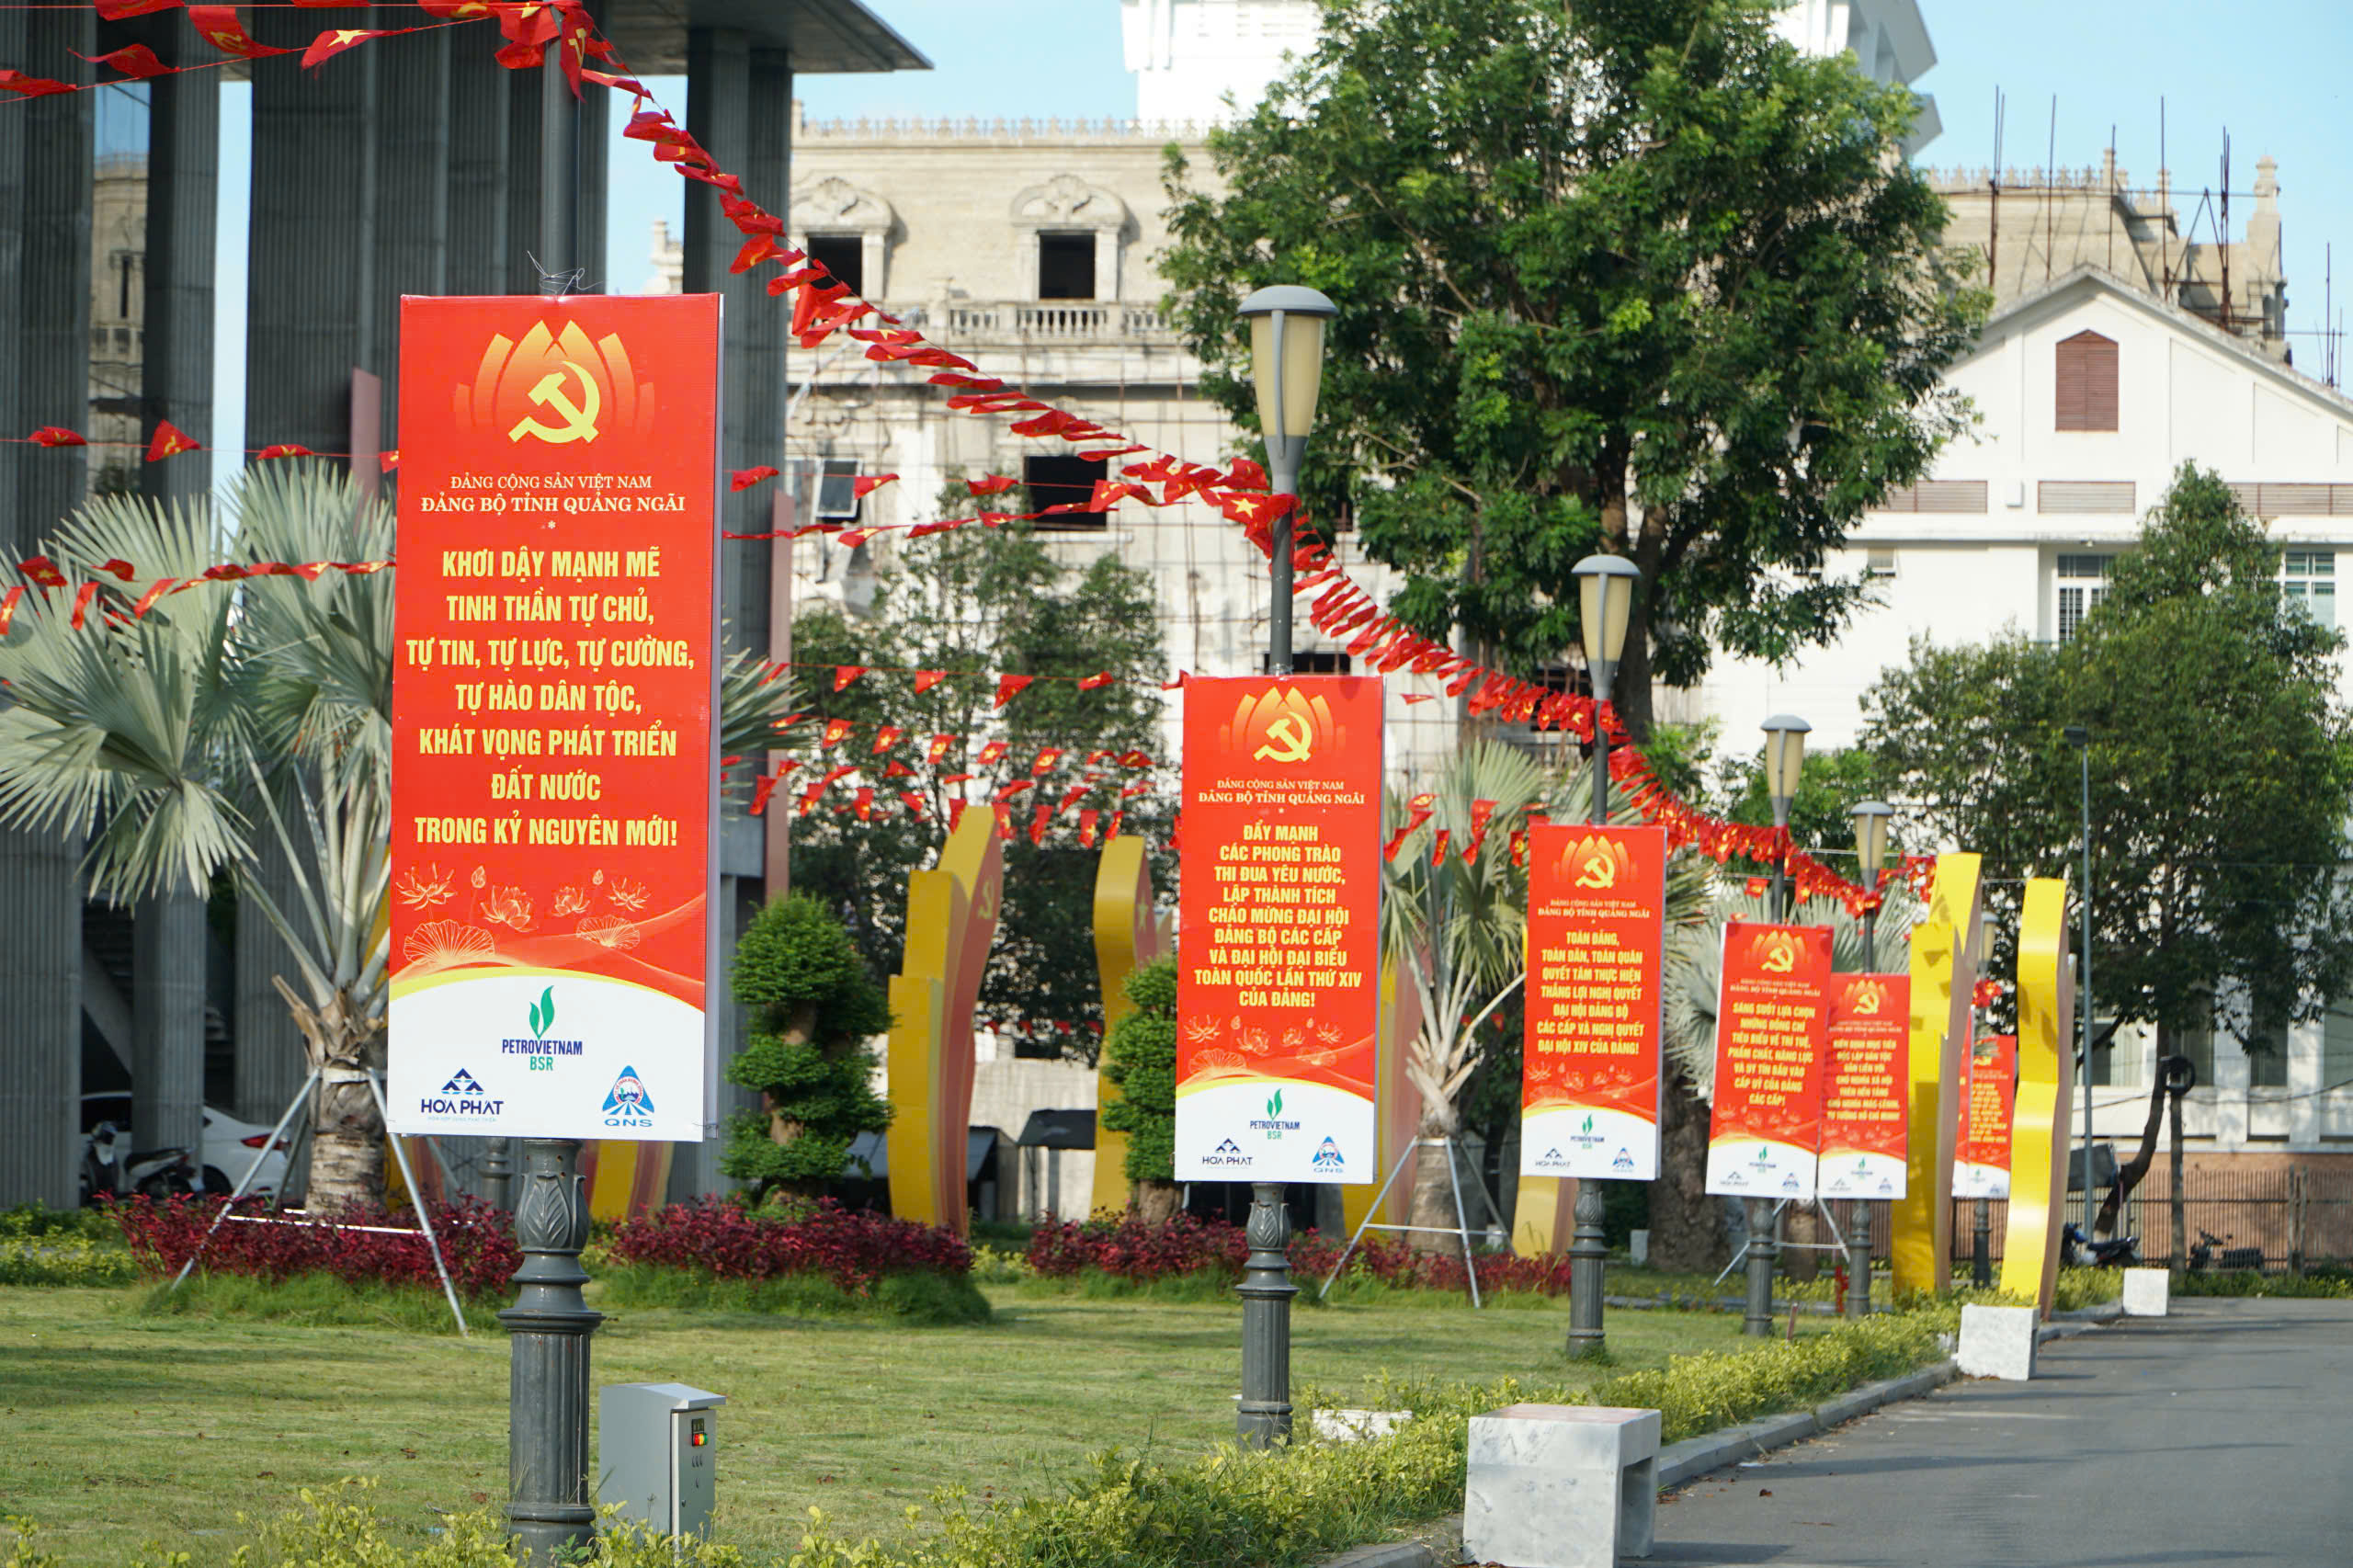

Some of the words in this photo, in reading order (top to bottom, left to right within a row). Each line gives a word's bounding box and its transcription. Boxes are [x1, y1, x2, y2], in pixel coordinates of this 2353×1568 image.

[451, 472, 493, 488] ĐẢNG
[497, 473, 540, 491] CỘNG
[544, 472, 574, 488] SẢN
[577, 473, 613, 493] VIỆT
[618, 476, 652, 488] NAM
[421, 492, 475, 511] ĐẢNG
[480, 493, 506, 516] BỘ
[511, 492, 559, 511] TỈNH
[563, 493, 632, 515] QUẢNG
[636, 493, 686, 511] NGÃI
[443, 549, 494, 576] KHƠI
[502, 546, 544, 583] DẬY
[551, 551, 618, 583] MẠNH
[626, 546, 660, 577] MẼ
[446, 596, 496, 621] TINH
[503, 586, 562, 621] THẦN
[568, 593, 598, 627] TỰ
[603, 587, 654, 625] CHỦ,
[406, 637, 435, 671] TỰ
[439, 640, 481, 669] TIN,
[488, 637, 517, 671] TỰ
[522, 638, 569, 672] LỰC,
[576, 638, 607, 672] TỰ
[611, 634, 694, 669] CƯỜNG,
[456, 682, 483, 715] TỰ
[489, 678, 532, 710] HÀO
[540, 679, 585, 710] DÂN
[593, 679, 641, 717] TỘC,
[420, 723, 475, 754] KHÁT
[483, 729, 540, 760] VỌNG
[549, 724, 605, 756] PHÁT
[612, 720, 676, 756] TRIỂN
[491, 765, 533, 799] ĐẤT
[540, 768, 601, 801] NƯỚC
[415, 817, 486, 844] TRONG
[494, 810, 521, 844] KỶ
[529, 814, 618, 846] NGUYÊN
[626, 814, 676, 846] MỚI!
[1244, 820, 1271, 840] ĐẨY
[1276, 825, 1318, 845] MẠNH
[1221, 842, 1248, 861] CÁC
[1253, 846, 1301, 862] PHONG
[1305, 844, 1341, 862] TRÀO
[1214, 866, 1236, 881] THI
[1240, 866, 1268, 882] ĐUA
[1272, 864, 1299, 882] YÊU
[1302, 865, 1346, 886] NƯỚC,
[1223, 884, 1250, 905] LẬP
[1254, 885, 1301, 903] THÀNH
[1304, 885, 1336, 903] TÍCH
[1209, 904, 1246, 925] CHÀO
[1250, 905, 1293, 926] MỪNG
[1297, 909, 1321, 928] ĐẠI
[1324, 906, 1349, 929] HỘI
[1214, 923, 1253, 945] ĐẢNG
[1257, 926, 1277, 948] BỘ
[1281, 926, 1309, 945] CÁC
[1313, 925, 1342, 946] CẤP
[1210, 946, 1227, 966] VÀ
[1231, 949, 1255, 968] ĐẠI
[1259, 945, 1282, 969] HỘI
[1287, 950, 1310, 969] ĐẠI
[1314, 946, 1347, 967] BIỂU
[1195, 967, 1231, 985] TOÀN
[1235, 965, 1272, 987] QUỐC
[1277, 965, 1303, 986] LẦN
[1308, 969, 1336, 987] THỨ
[1339, 971, 1361, 987] XIV
[1239, 986, 1267, 1006] CỦA
[1271, 987, 1315, 1007] ĐẢNG!
[502, 1039, 583, 1055] PETROVIETNAM
[529, 1056, 553, 1071] BSR
[604, 1119, 653, 1127] QNS
[1250, 1120, 1301, 1131] PETROVIETNAM
[1267, 1131, 1282, 1140] BSR
